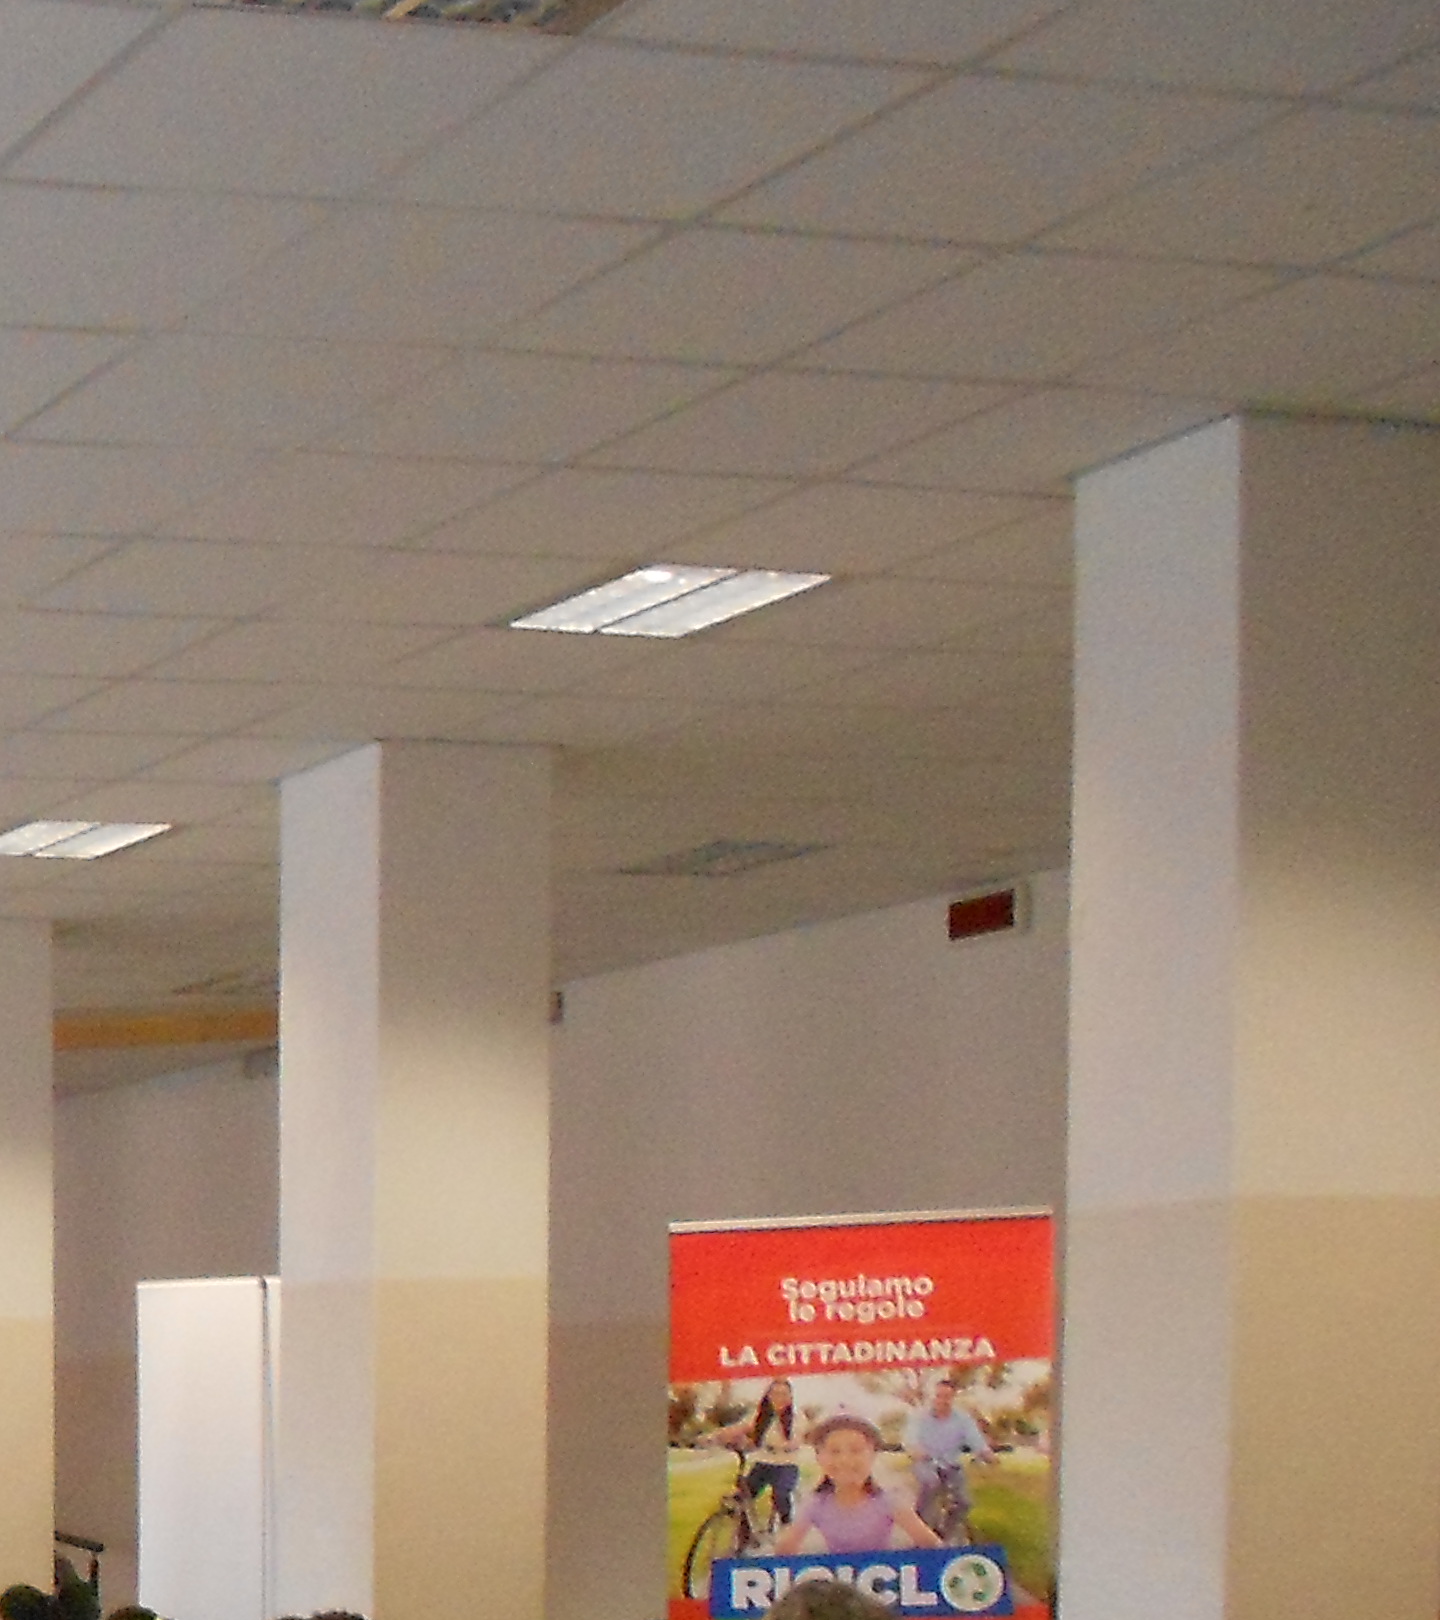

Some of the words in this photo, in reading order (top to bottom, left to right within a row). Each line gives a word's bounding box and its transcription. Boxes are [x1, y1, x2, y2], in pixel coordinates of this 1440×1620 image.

[780, 1273, 935, 1303] Seguiamo
[789, 1298, 817, 1323] le
[824, 1294, 926, 1324] regole
[720, 1345, 760, 1367] LA
[767, 1337, 996, 1366] CITTADINANZA
